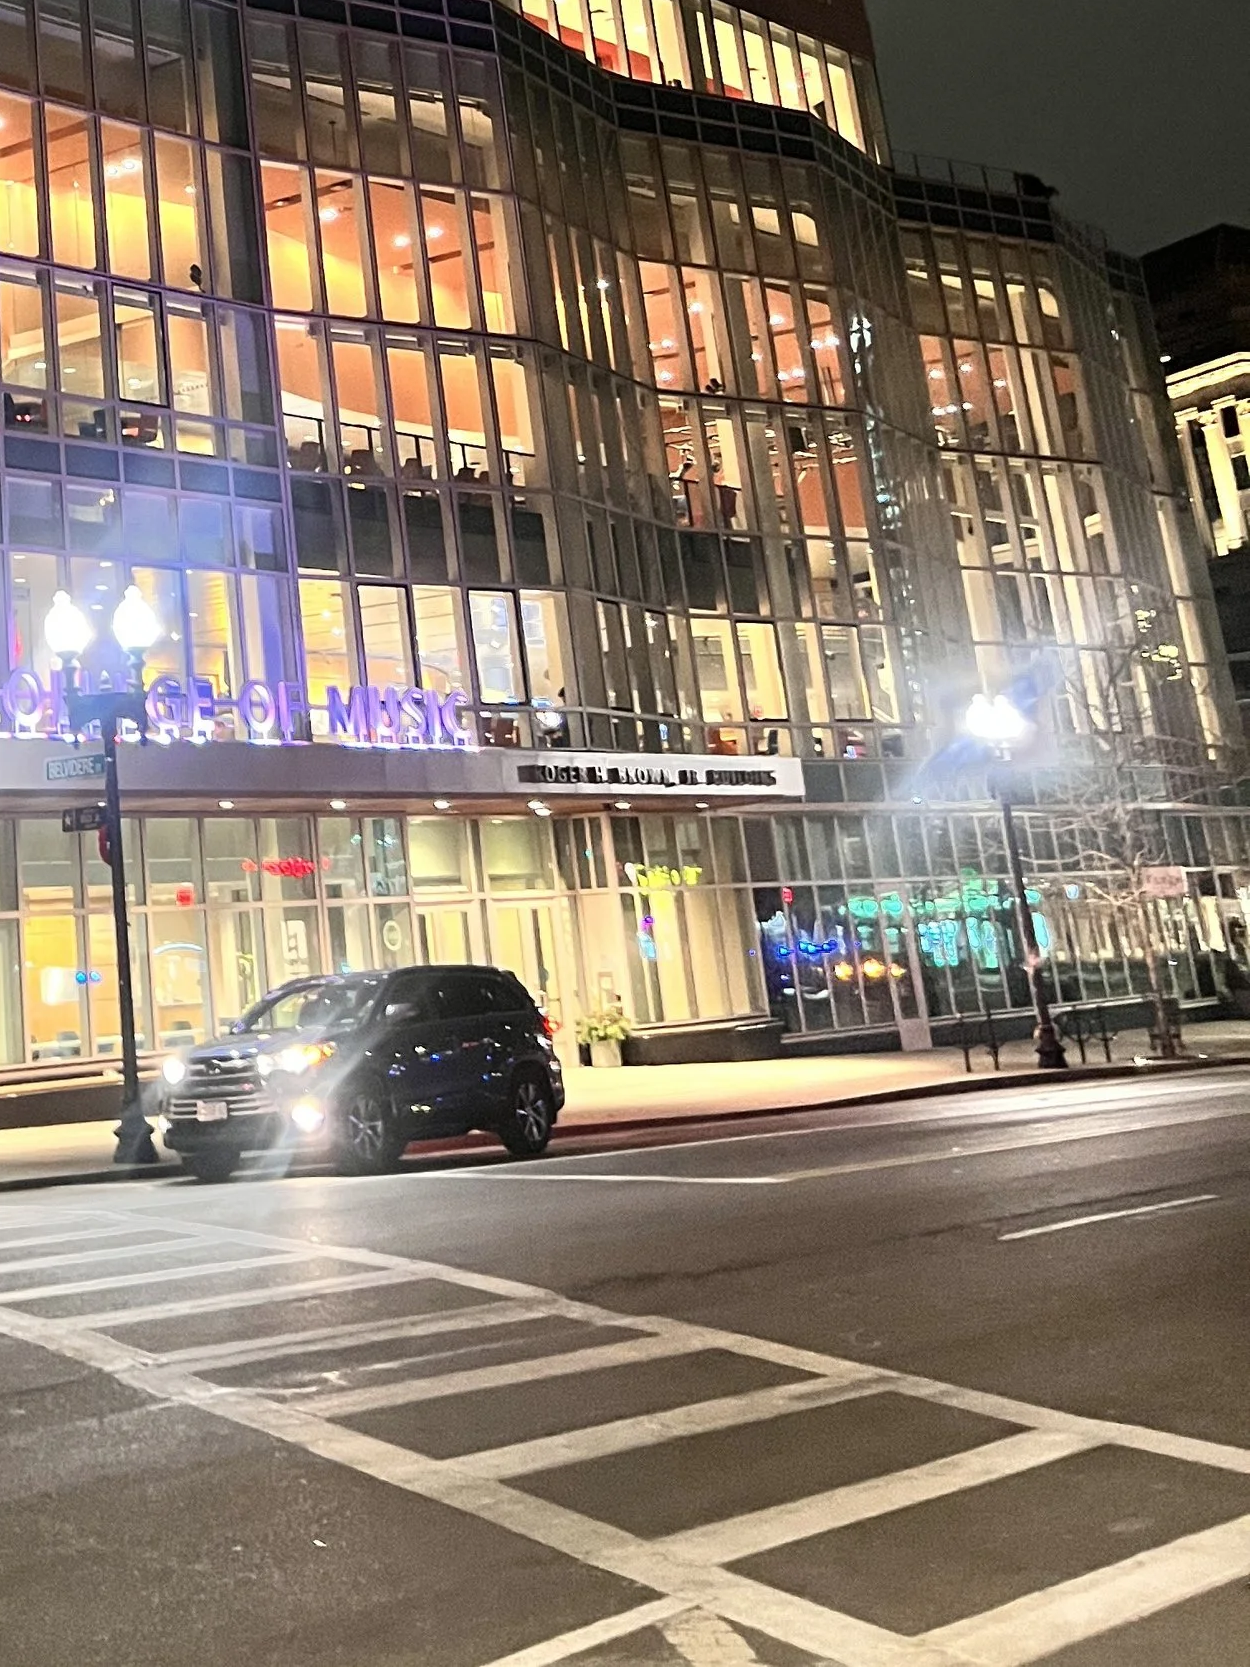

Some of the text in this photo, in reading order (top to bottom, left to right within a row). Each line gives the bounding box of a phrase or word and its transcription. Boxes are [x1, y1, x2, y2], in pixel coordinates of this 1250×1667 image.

[238, 680, 308, 737] OF
[327, 684, 472, 742] MUSIC
[534, 764, 590, 784] ROGER
